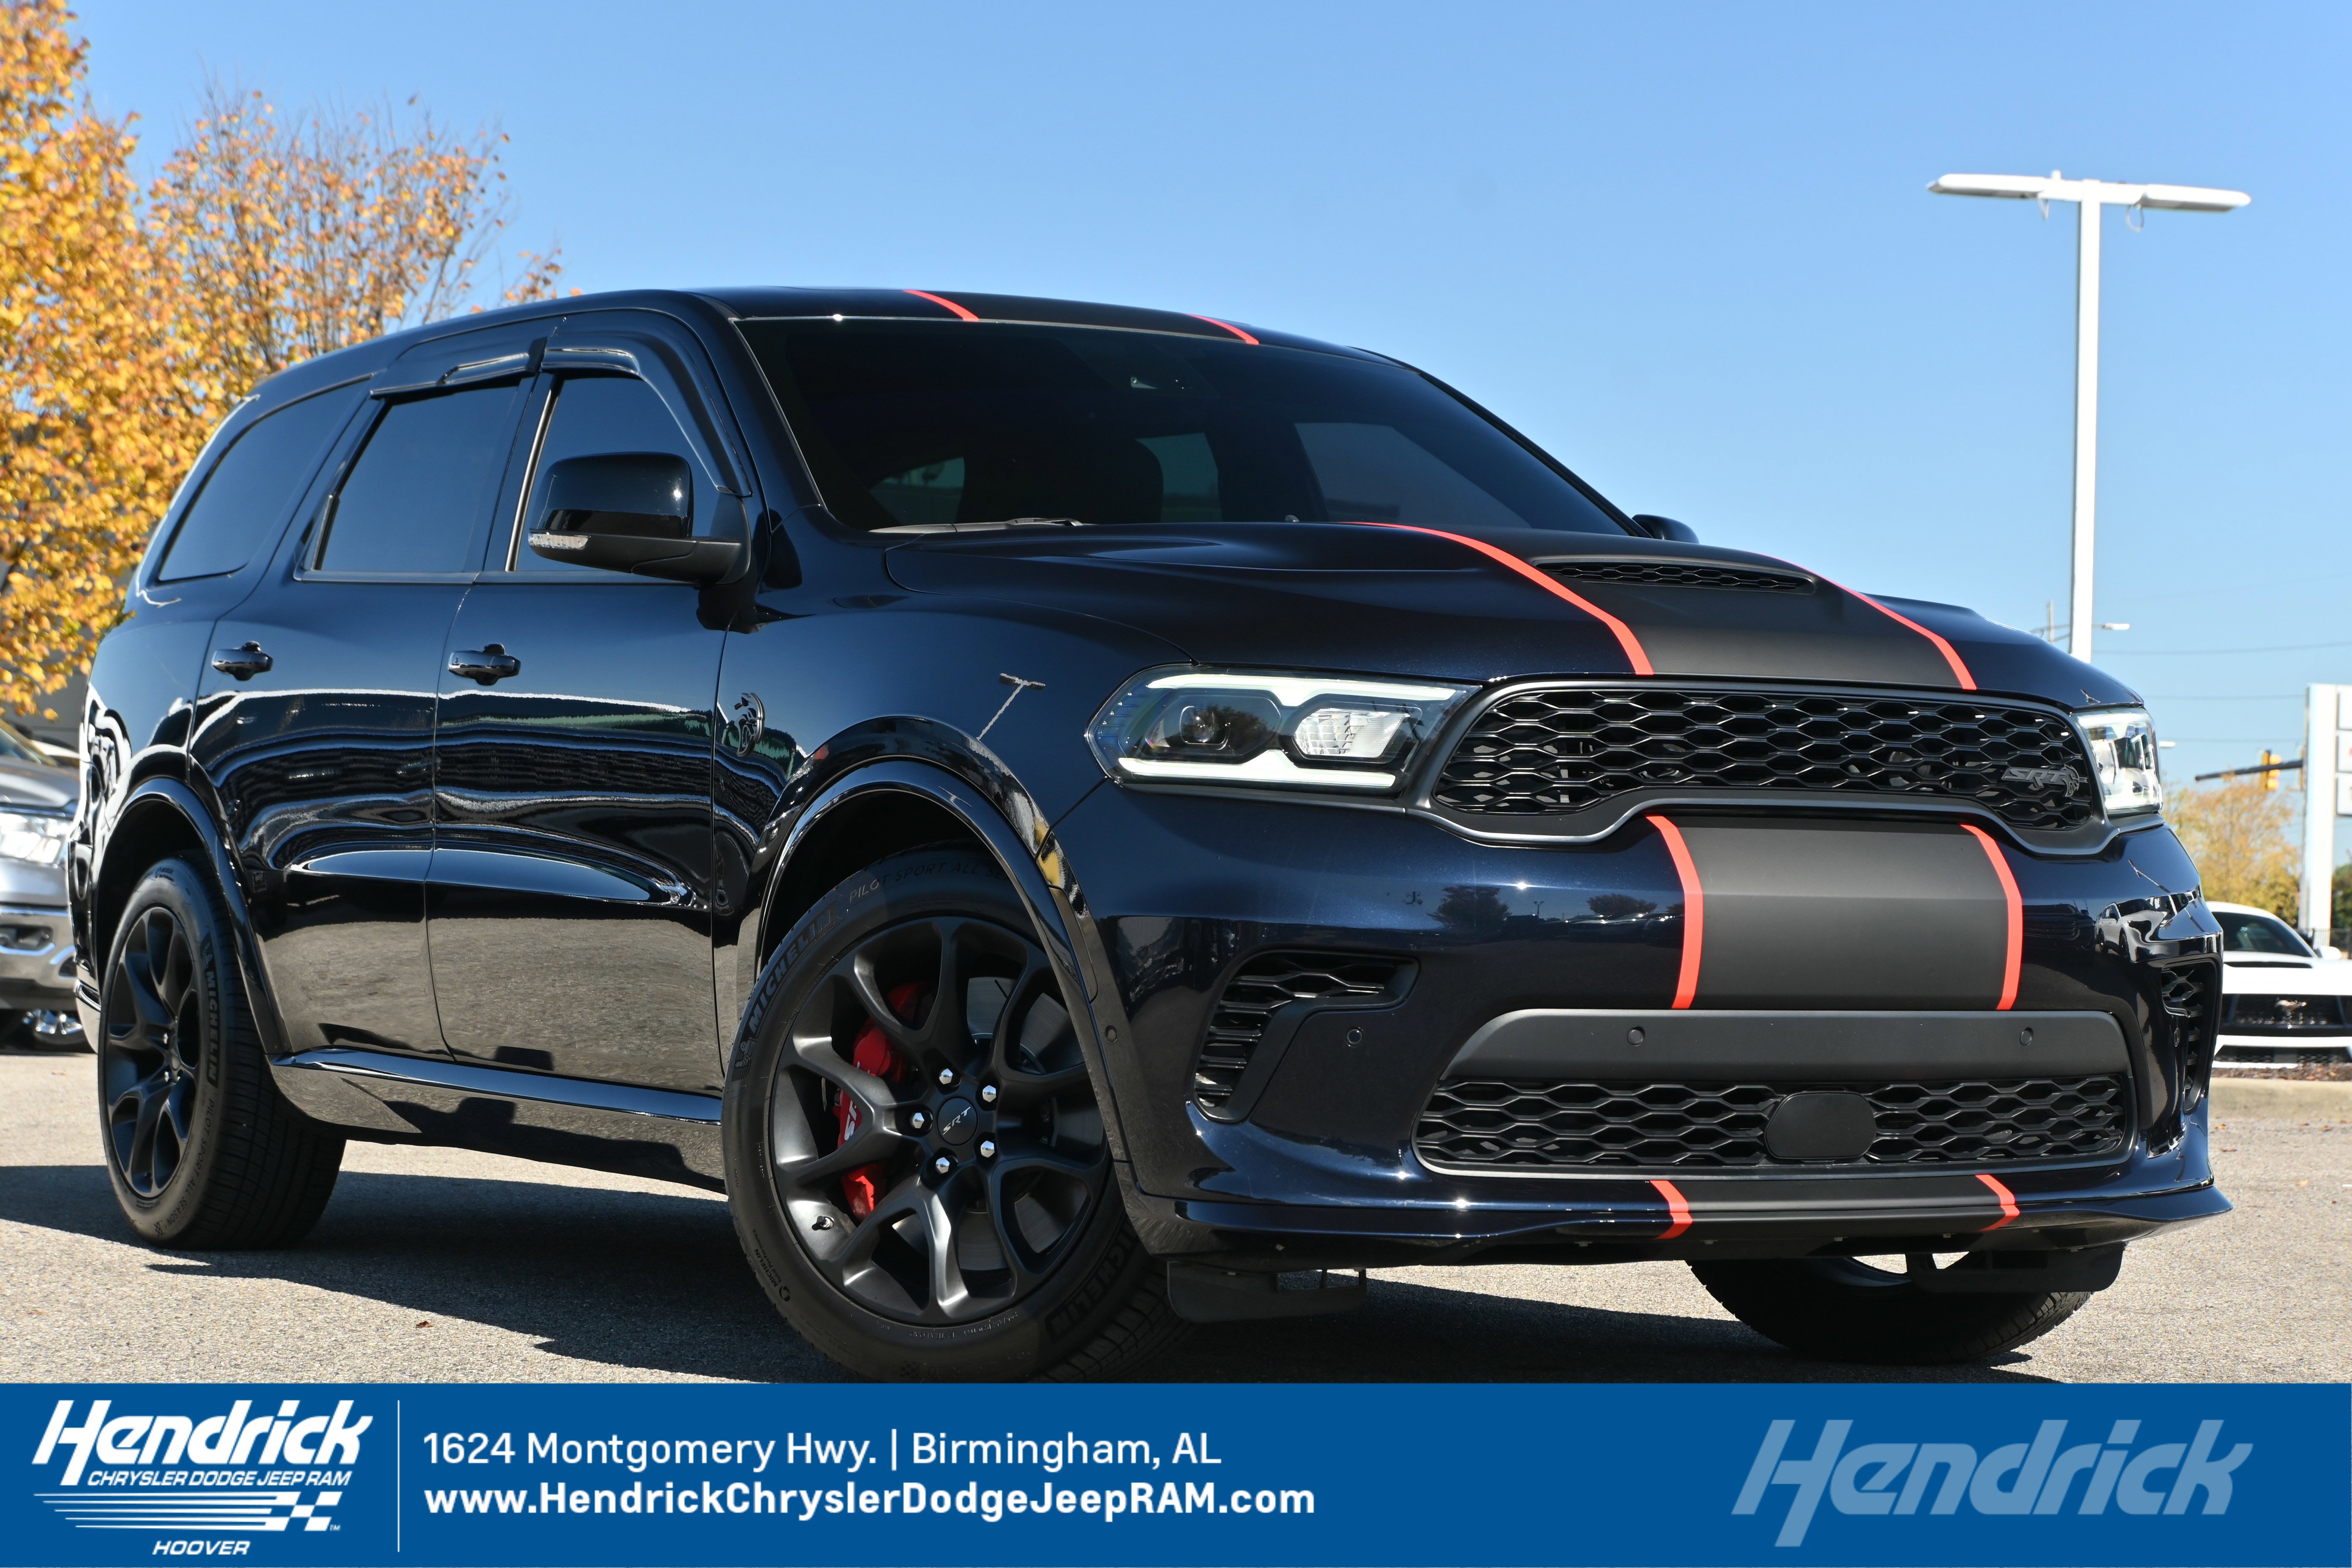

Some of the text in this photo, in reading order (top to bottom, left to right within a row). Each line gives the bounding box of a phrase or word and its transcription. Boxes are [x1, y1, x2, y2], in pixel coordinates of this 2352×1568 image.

[2004, 768, 2066, 788] SRT
[849, 874, 890, 903] PILOT
[895, 862, 947, 882] SPORT
[950, 862, 978, 875] ALL
[748, 909, 832, 1034] MICHELIN
[206, 971, 218, 1081] MICHELIN
[204, 1098, 215, 1136] PILOT
[942, 1106, 971, 1135] SRT
[193, 1138, 207, 1178] SPORT
[185, 1179, 196, 1198] ALL
[166, 1196, 187, 1227] SEASON
[752, 1229, 782, 1283] Total Performance
[754, 1249, 779, 1287] MICHELIN
